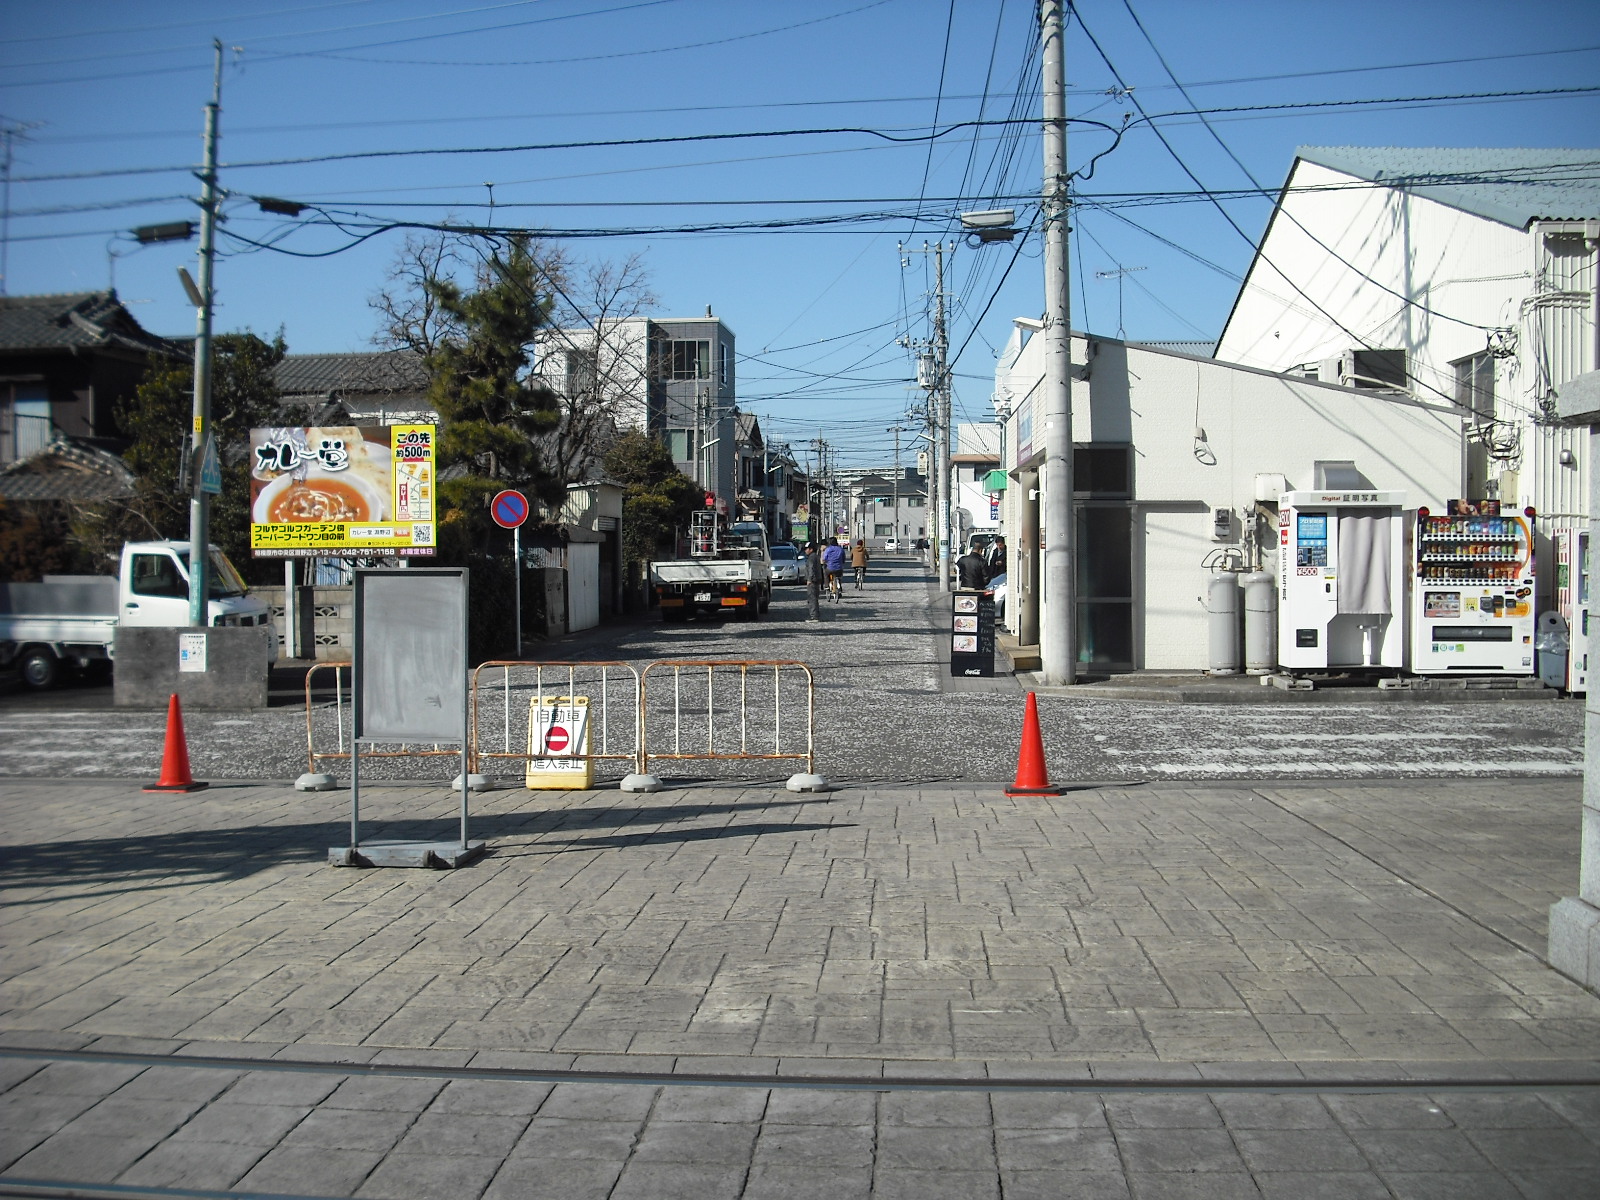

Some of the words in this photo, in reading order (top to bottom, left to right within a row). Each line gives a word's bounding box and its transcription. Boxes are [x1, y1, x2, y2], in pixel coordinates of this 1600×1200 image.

[397, 433, 430, 444] この先
[396, 446, 430, 458] 約500m
[1343, 494, 1378, 502] 証明写真
[1297, 568, 1317, 576] ¥500
[536, 709, 581, 724] 自動車
